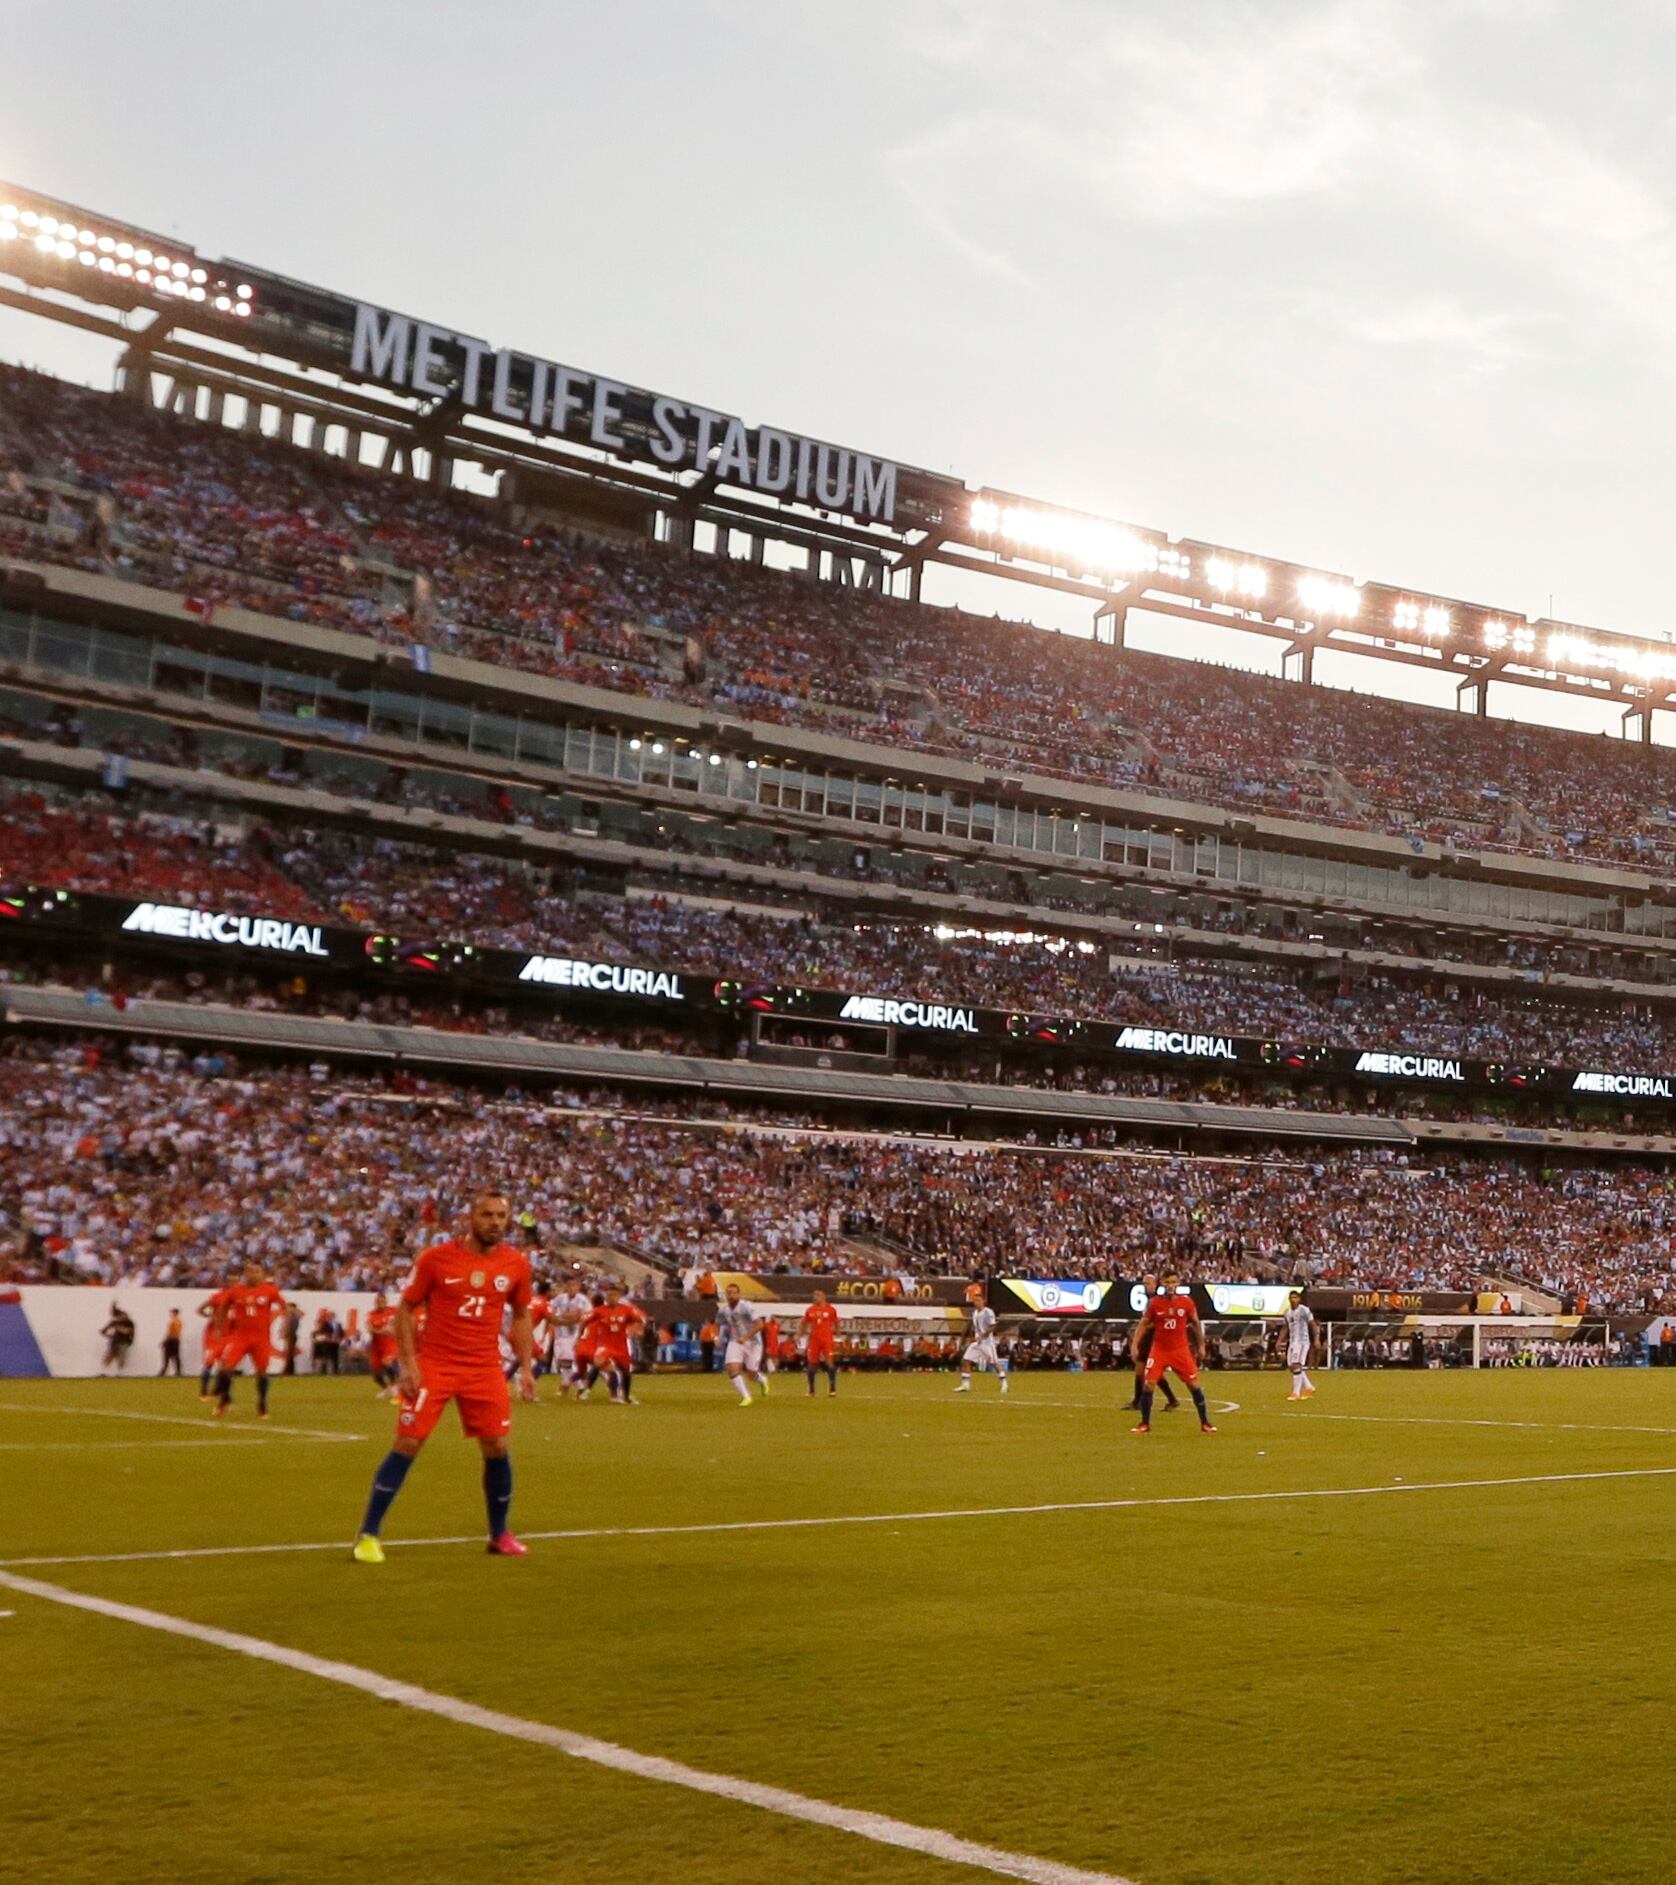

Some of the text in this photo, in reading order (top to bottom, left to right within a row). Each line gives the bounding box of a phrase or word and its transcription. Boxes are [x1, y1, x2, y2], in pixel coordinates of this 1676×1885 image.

[350, 303, 629, 448] METLIFE
[649, 398, 898, 521] STADIUM
[121, 902, 329, 956] MERCURIAL
[518, 955, 684, 999] MERCURIAL
[840, 996, 979, 1033] MERCURIAL
[1115, 1028, 1237, 1060] MERCURIAL
[1355, 1052, 1464, 1081] MERCURIAL
[1572, 1072, 1672, 1098] MERCURIAL
[458, 1295, 487, 1318] 21
[1164, 1319, 1177, 1330] 20
[415, 1387, 428, 1412] 1
